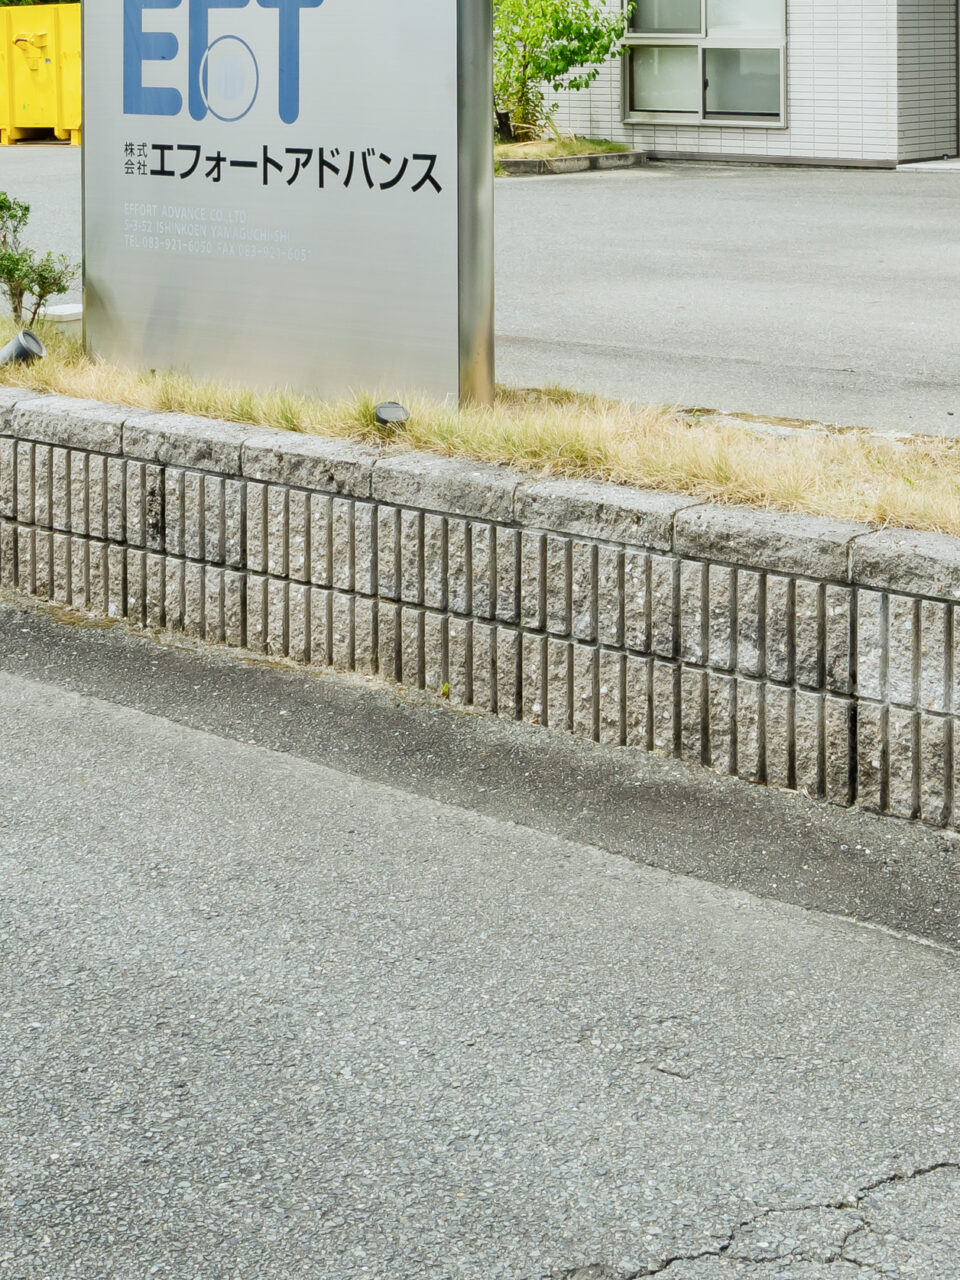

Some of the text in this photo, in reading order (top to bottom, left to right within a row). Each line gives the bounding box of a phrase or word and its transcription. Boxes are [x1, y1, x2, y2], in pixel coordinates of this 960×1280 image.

[150, 143, 443, 193] エフォートアドバンス
[124, 203, 157, 218] EFFORT
[161, 205, 205, 221] ADVANCE
[124, 234, 140, 248] TEL
